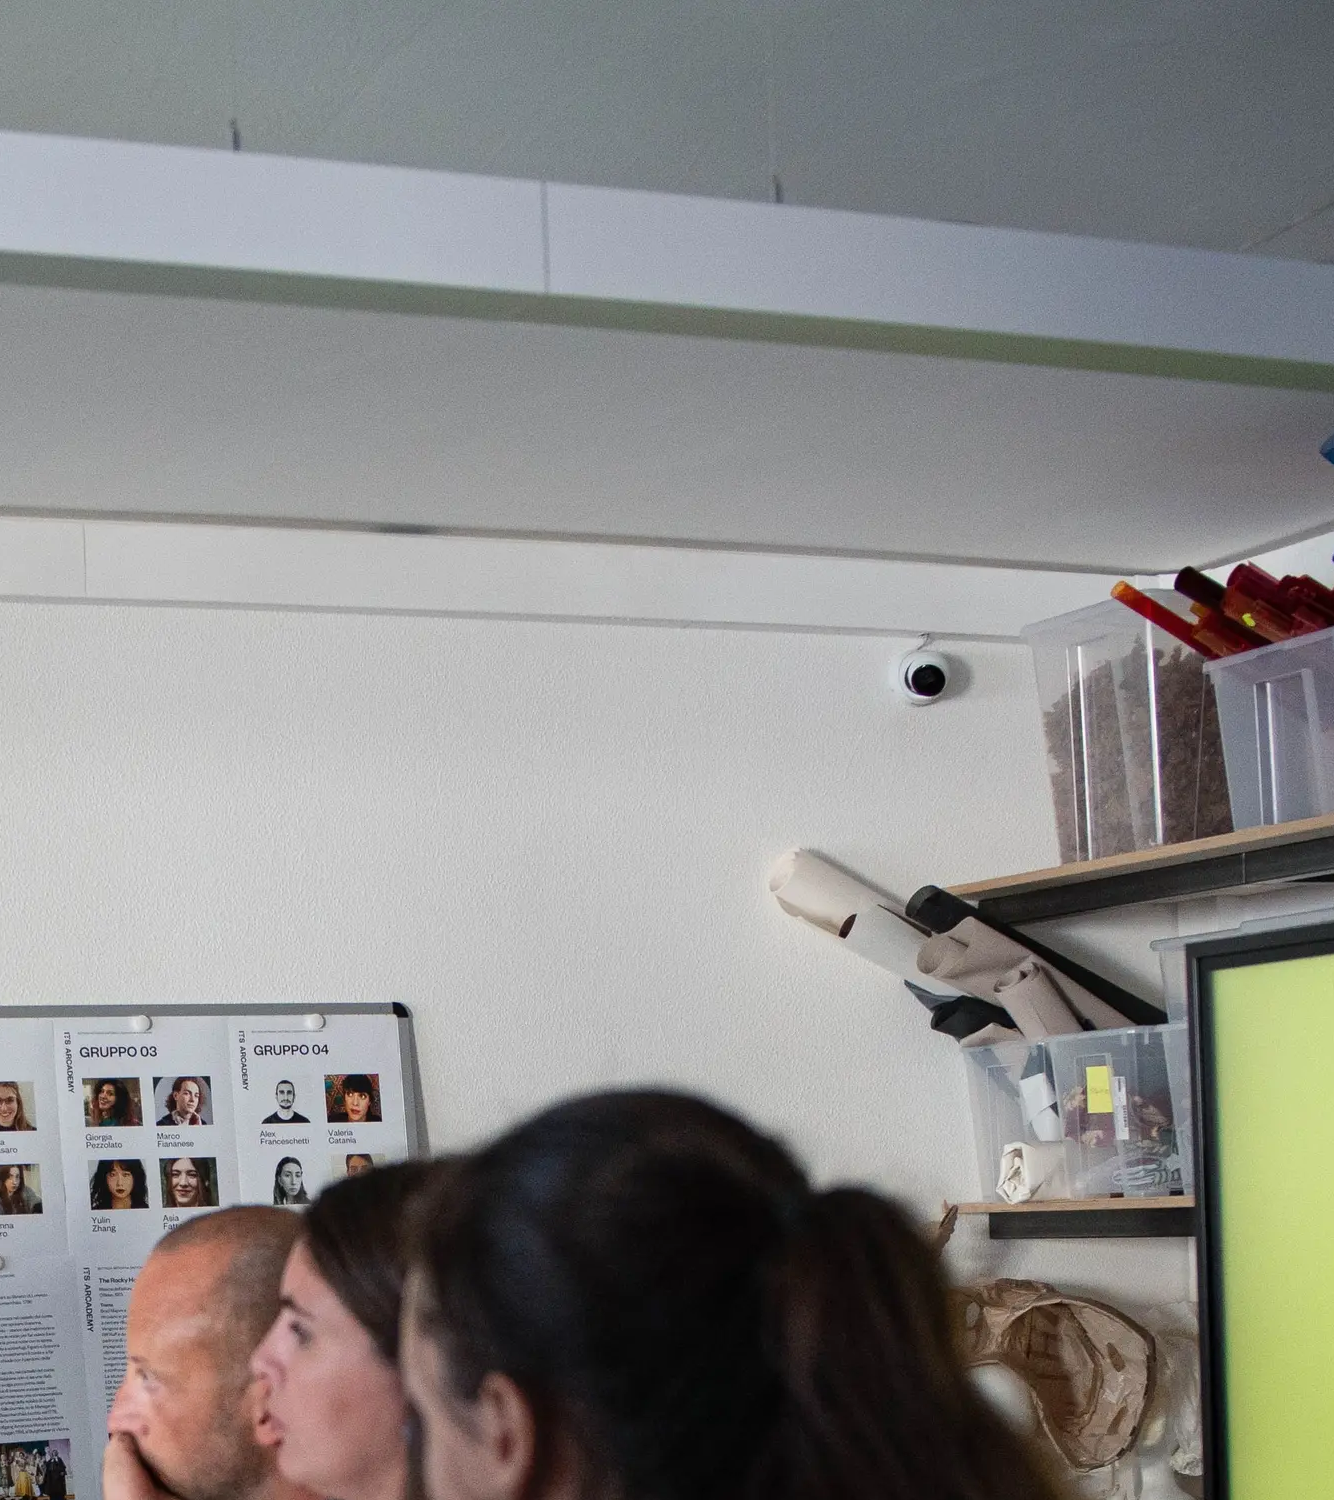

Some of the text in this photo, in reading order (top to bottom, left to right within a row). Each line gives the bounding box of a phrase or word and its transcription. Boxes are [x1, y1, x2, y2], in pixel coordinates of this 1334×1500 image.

[79, 1045, 158, 1058] GRUPPO 03
[253, 1044, 329, 1056] GRUPPO 04
[63, 1031, 75, 1094] ITS ARCADEMY
[238, 1030, 249, 1091] ITS ARCADEMY
[156, 1132, 180, 1140] Marco
[260, 1130, 276, 1138] Alex
[328, 1129, 354, 1137] Valeria
[85, 1133, 113, 1142] Giorgia
[86, 1141, 122, 1149] Pezzolato
[162, 1214, 179, 1222] Asia
[92, 1225, 116, 1233] Zhang
[83, 1266, 94, 1333] ITS ARCADEMY
